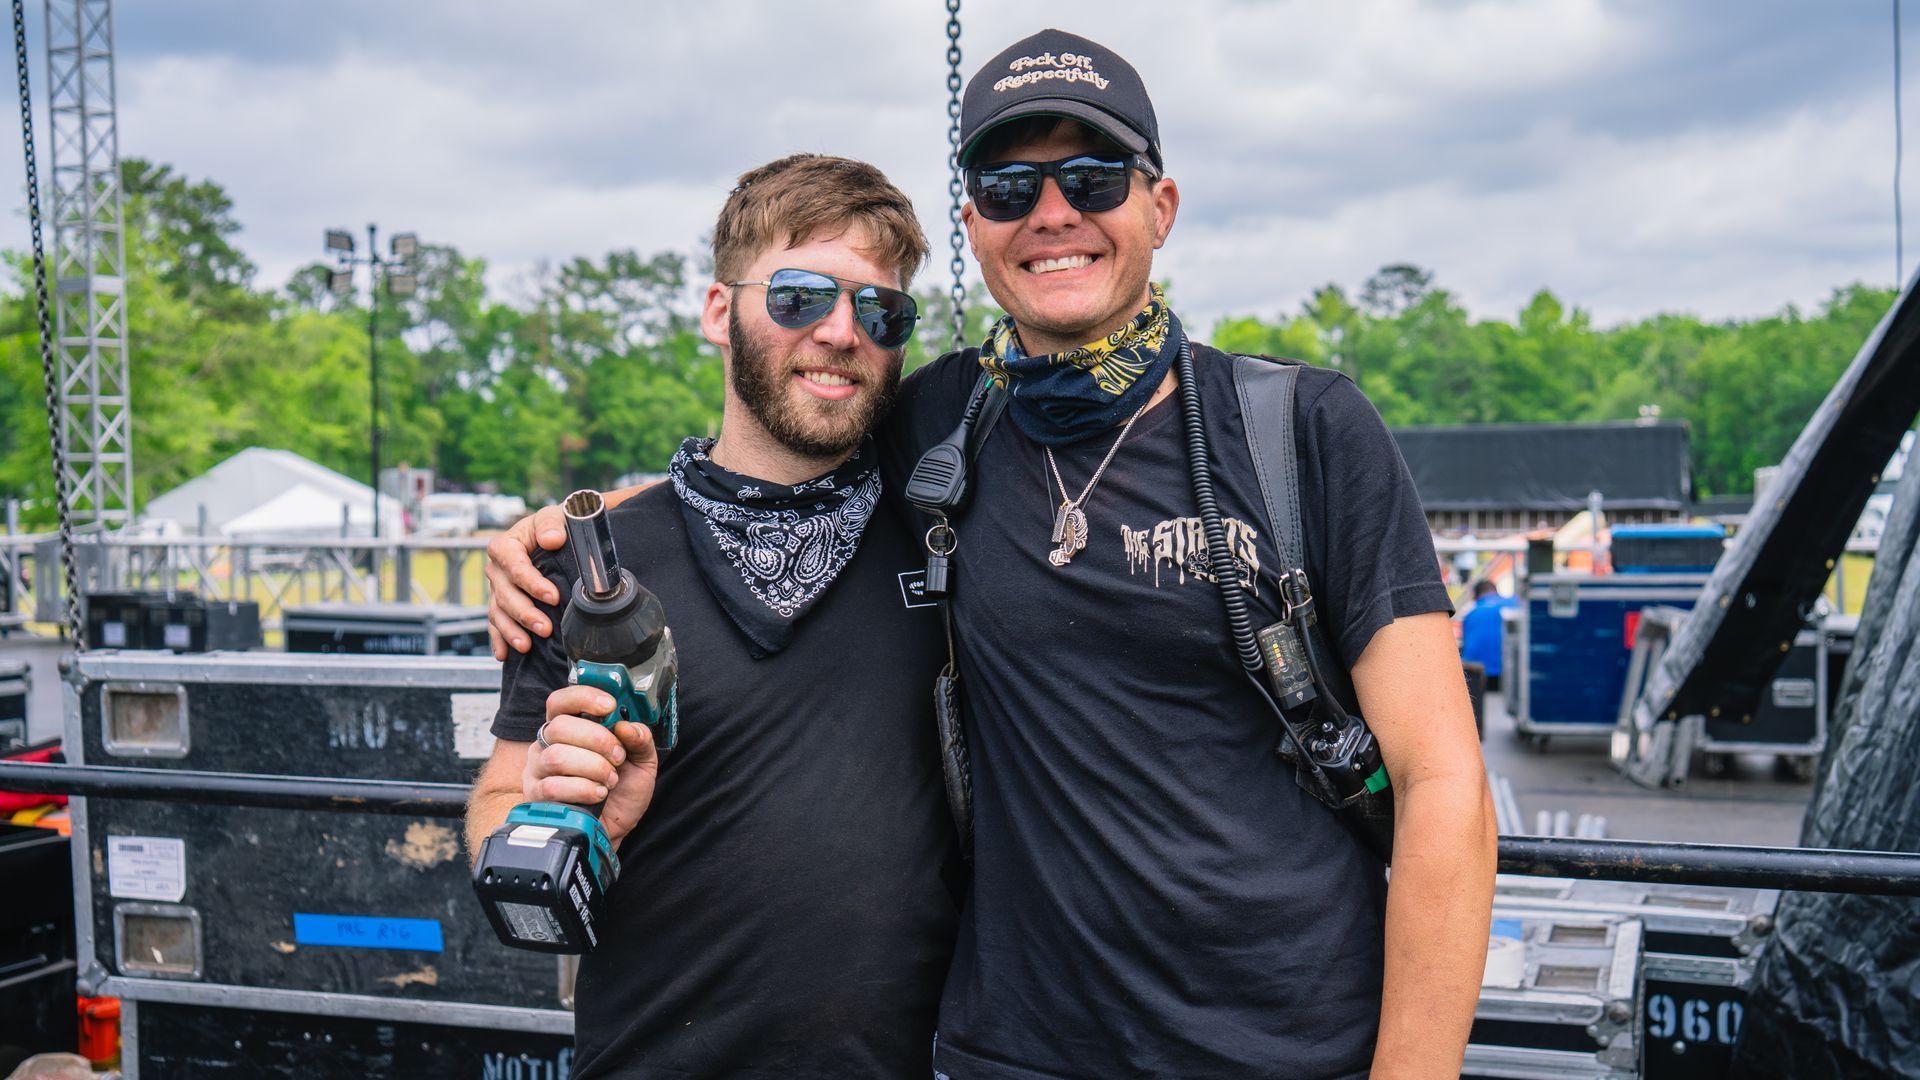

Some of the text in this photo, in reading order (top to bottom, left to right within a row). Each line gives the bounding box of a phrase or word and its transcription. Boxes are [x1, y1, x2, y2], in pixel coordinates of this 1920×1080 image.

[993, 68, 1110, 92] Respectfully
[1120, 523, 1151, 576] THE
[1152, 516, 1260, 598] STRTS
[1648, 994, 1744, 1045] 960
